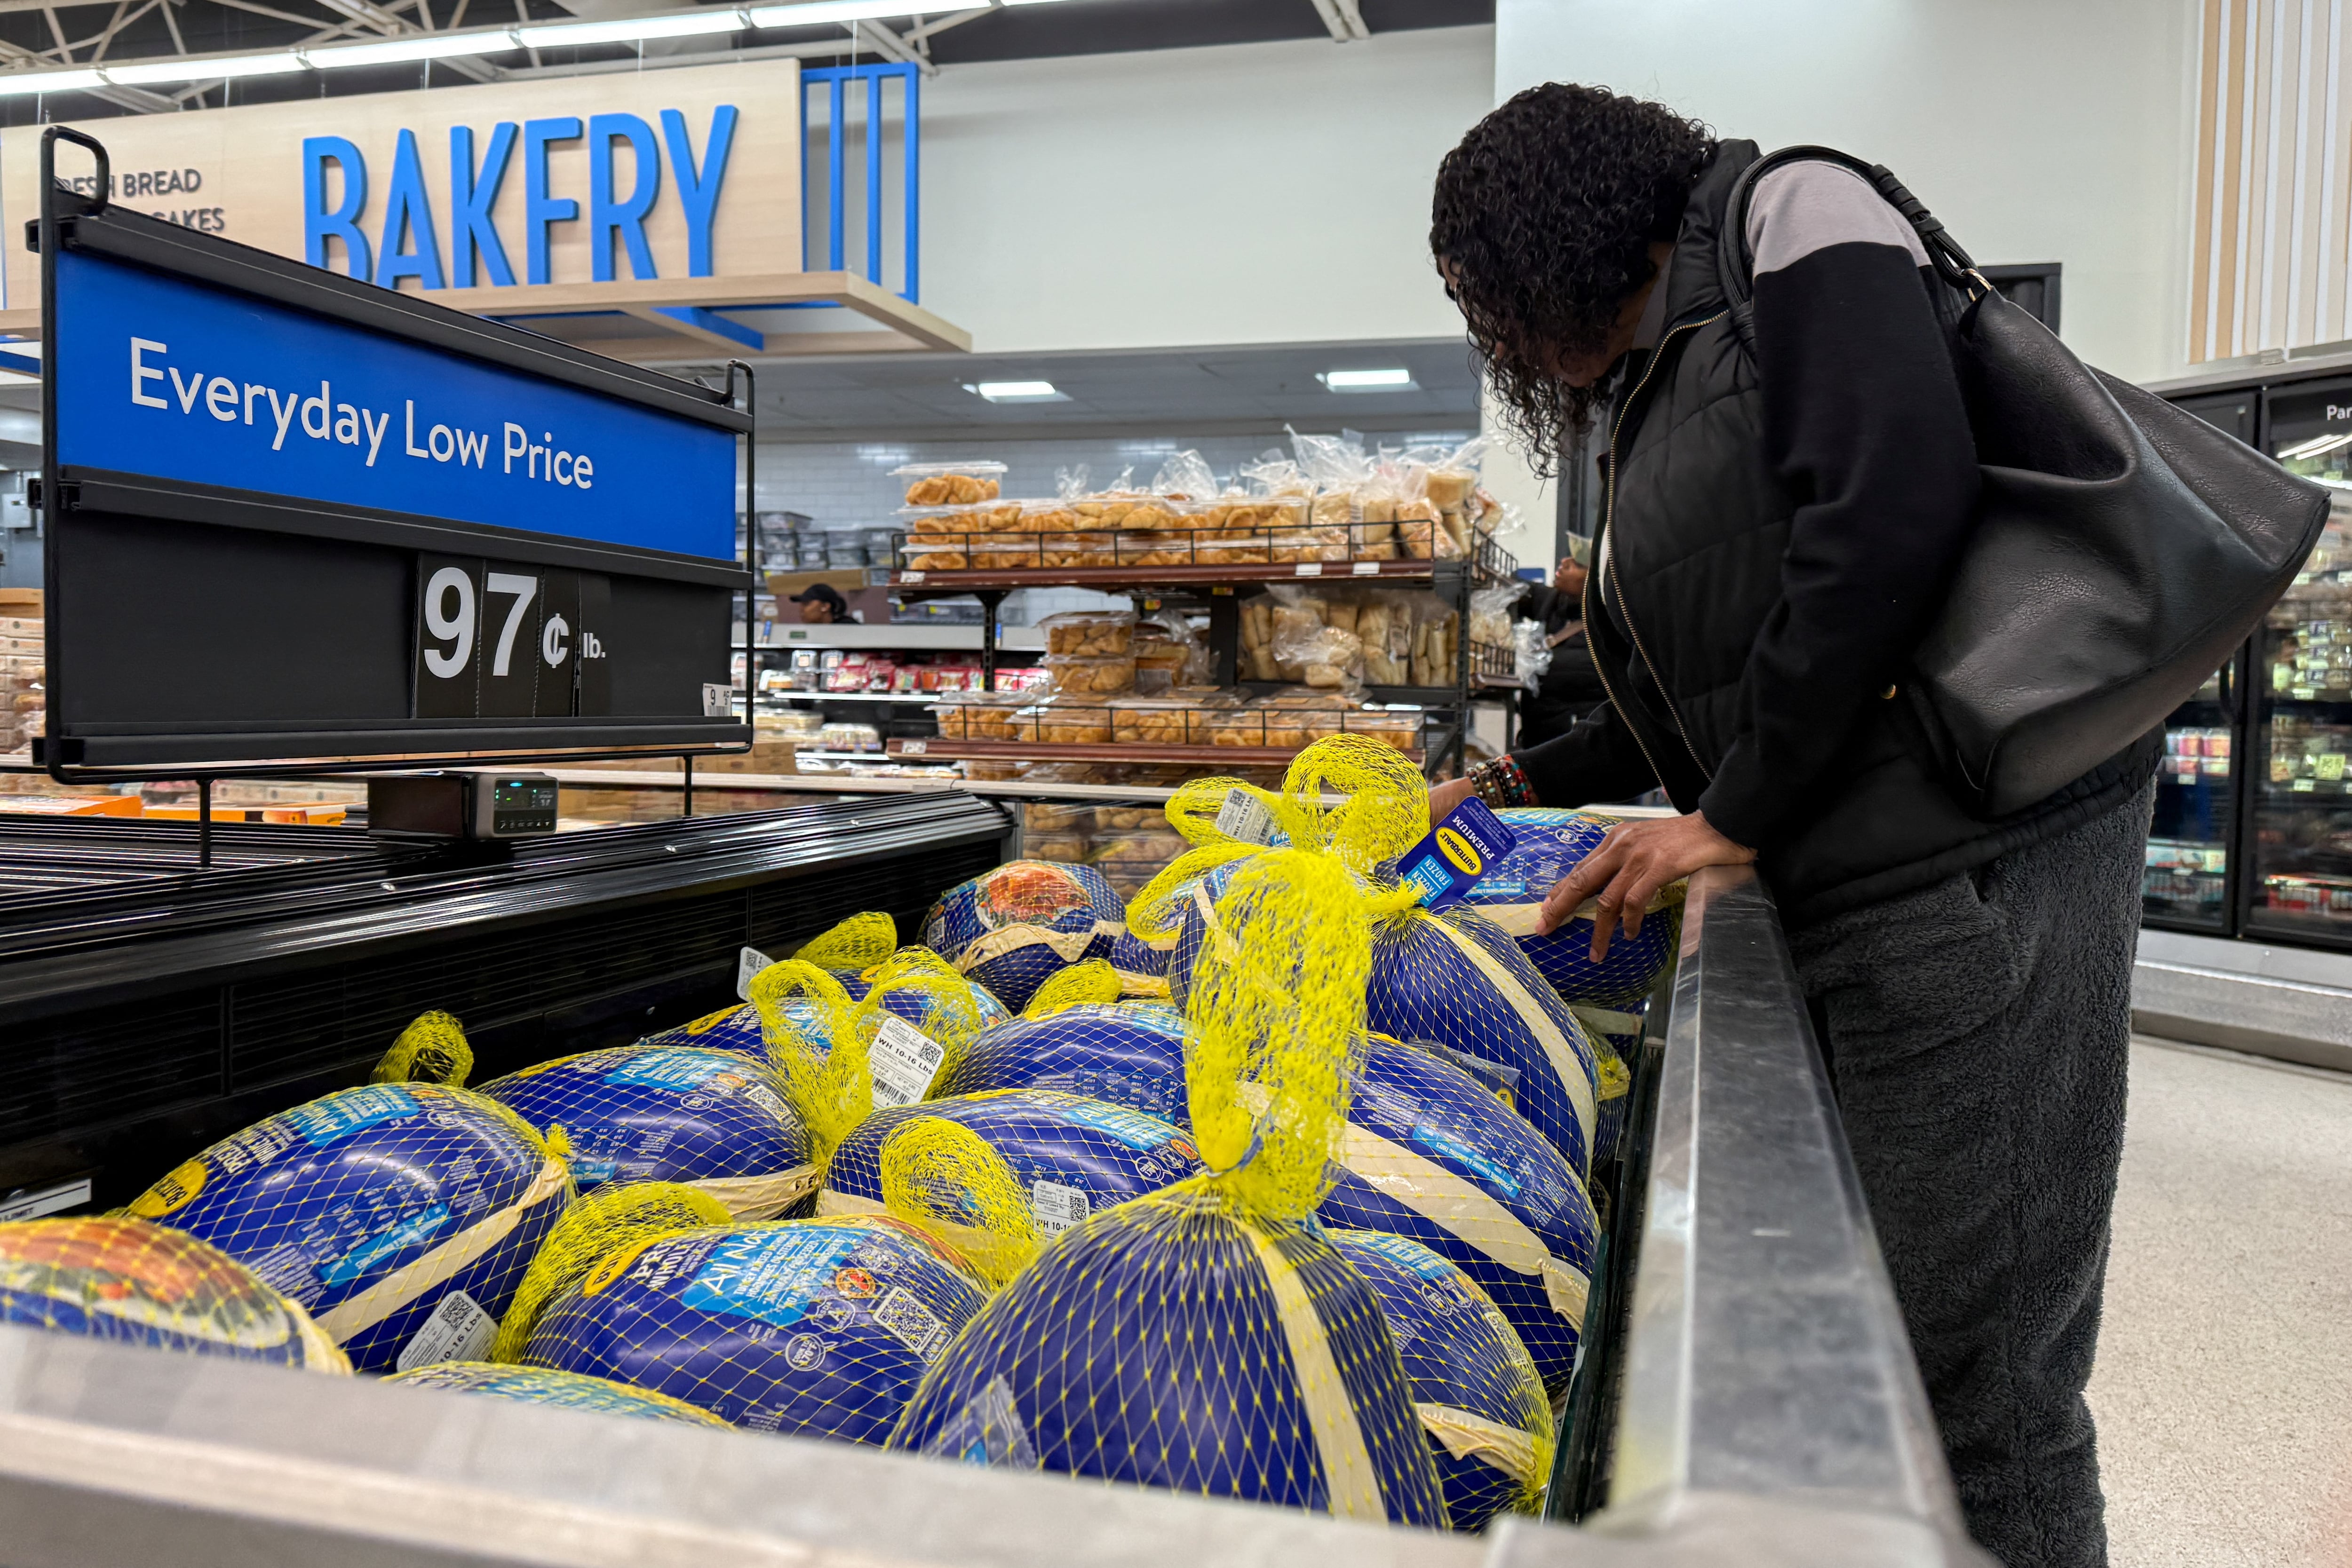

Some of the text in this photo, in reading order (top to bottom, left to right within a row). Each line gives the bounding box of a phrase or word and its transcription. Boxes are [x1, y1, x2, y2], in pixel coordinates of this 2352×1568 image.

[123, 168, 202, 198] BREAD
[302, 105, 739, 290] BAKERY
[153, 207, 225, 231] AKES
[130, 337, 594, 489] Everyday Low Price
[583, 633, 606, 658] lb.
[1233, 825, 1240, 836] WH
[1238, 808, 1248, 824] 10-16
[1452, 816, 1495, 860] PREMIUM
[1440, 832, 1477, 871] BUTTERBALL
[1424, 858, 1450, 886] FROZEN
[878, 1037, 893, 1050] WH
[895, 1048, 917, 1064] 10-16
[918, 1062, 933, 1075] Lbs
[702, 1263, 742, 1296] All
